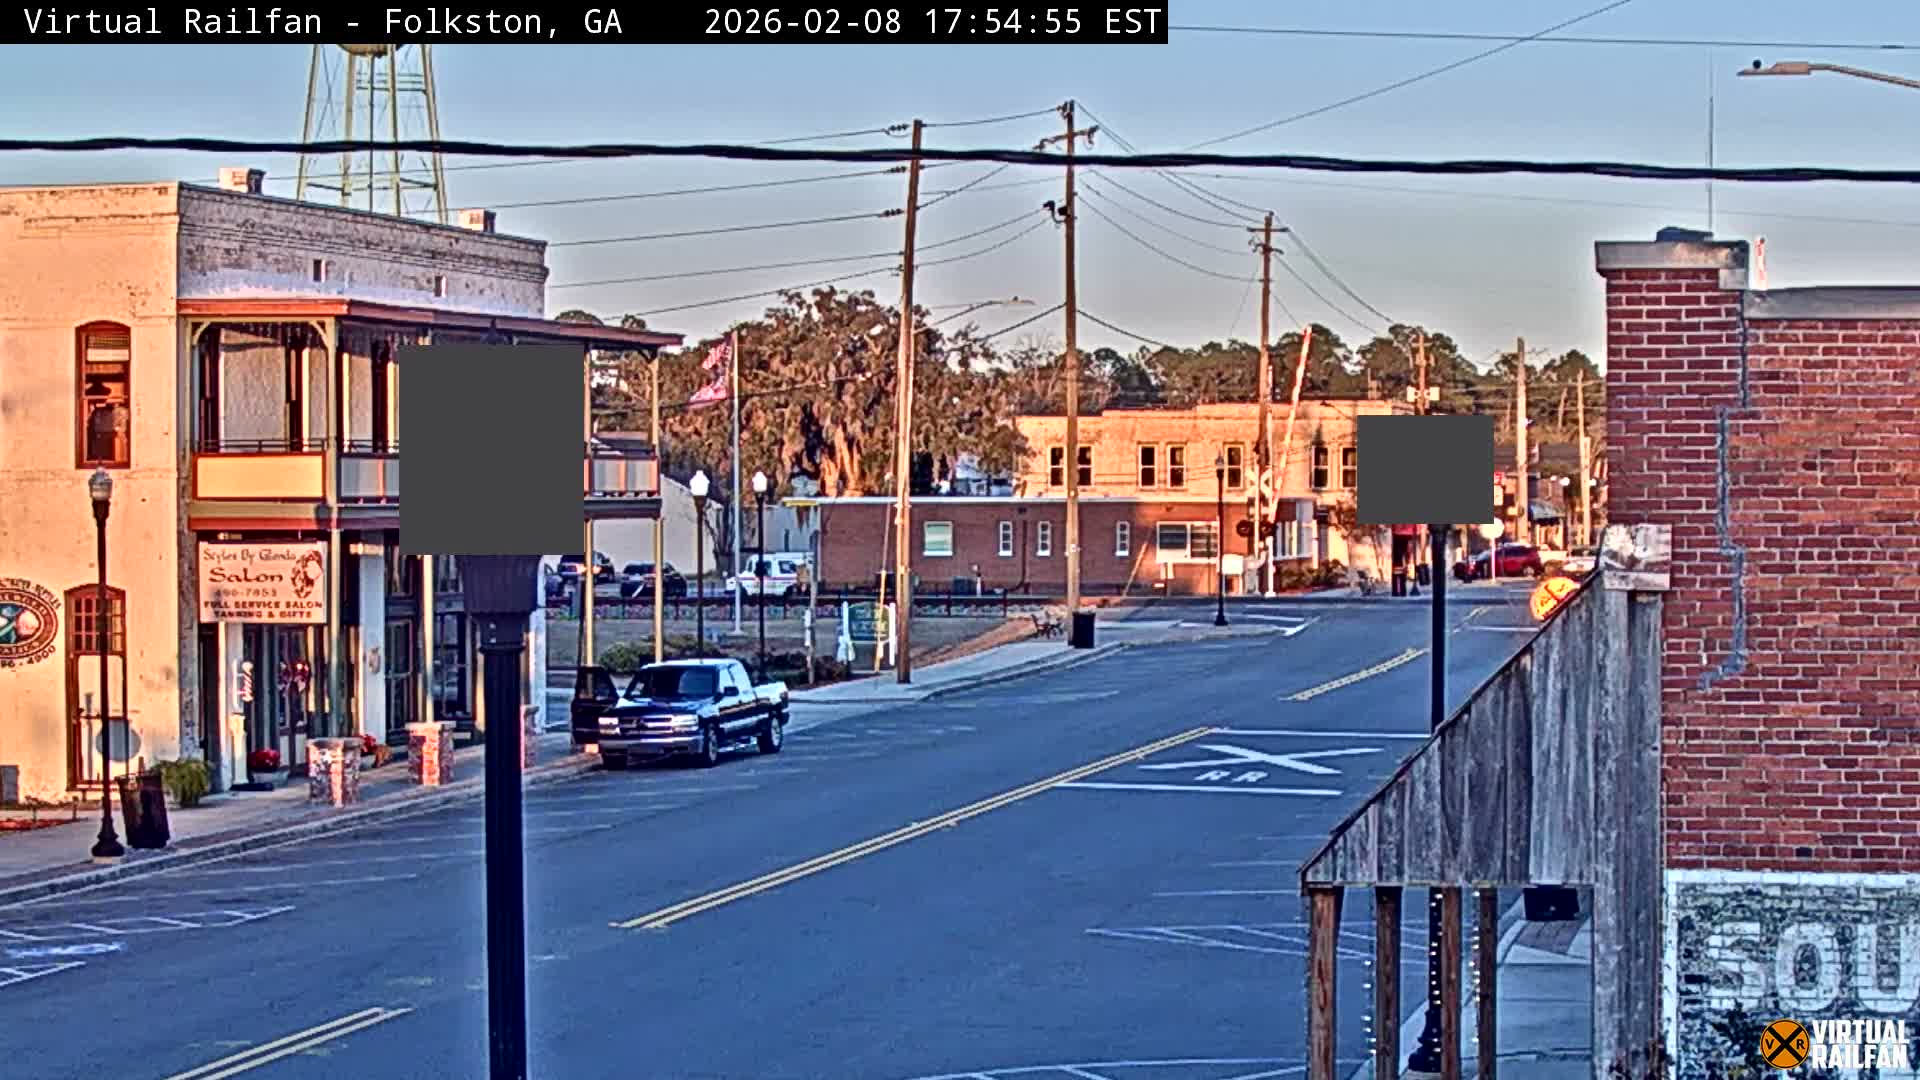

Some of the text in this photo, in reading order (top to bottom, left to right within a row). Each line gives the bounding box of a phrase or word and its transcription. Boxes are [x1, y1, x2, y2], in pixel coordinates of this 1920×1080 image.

[203, 600, 323, 609] FULL SERVICE SALON
[213, 610, 313, 619] TANNING & GIFTS
